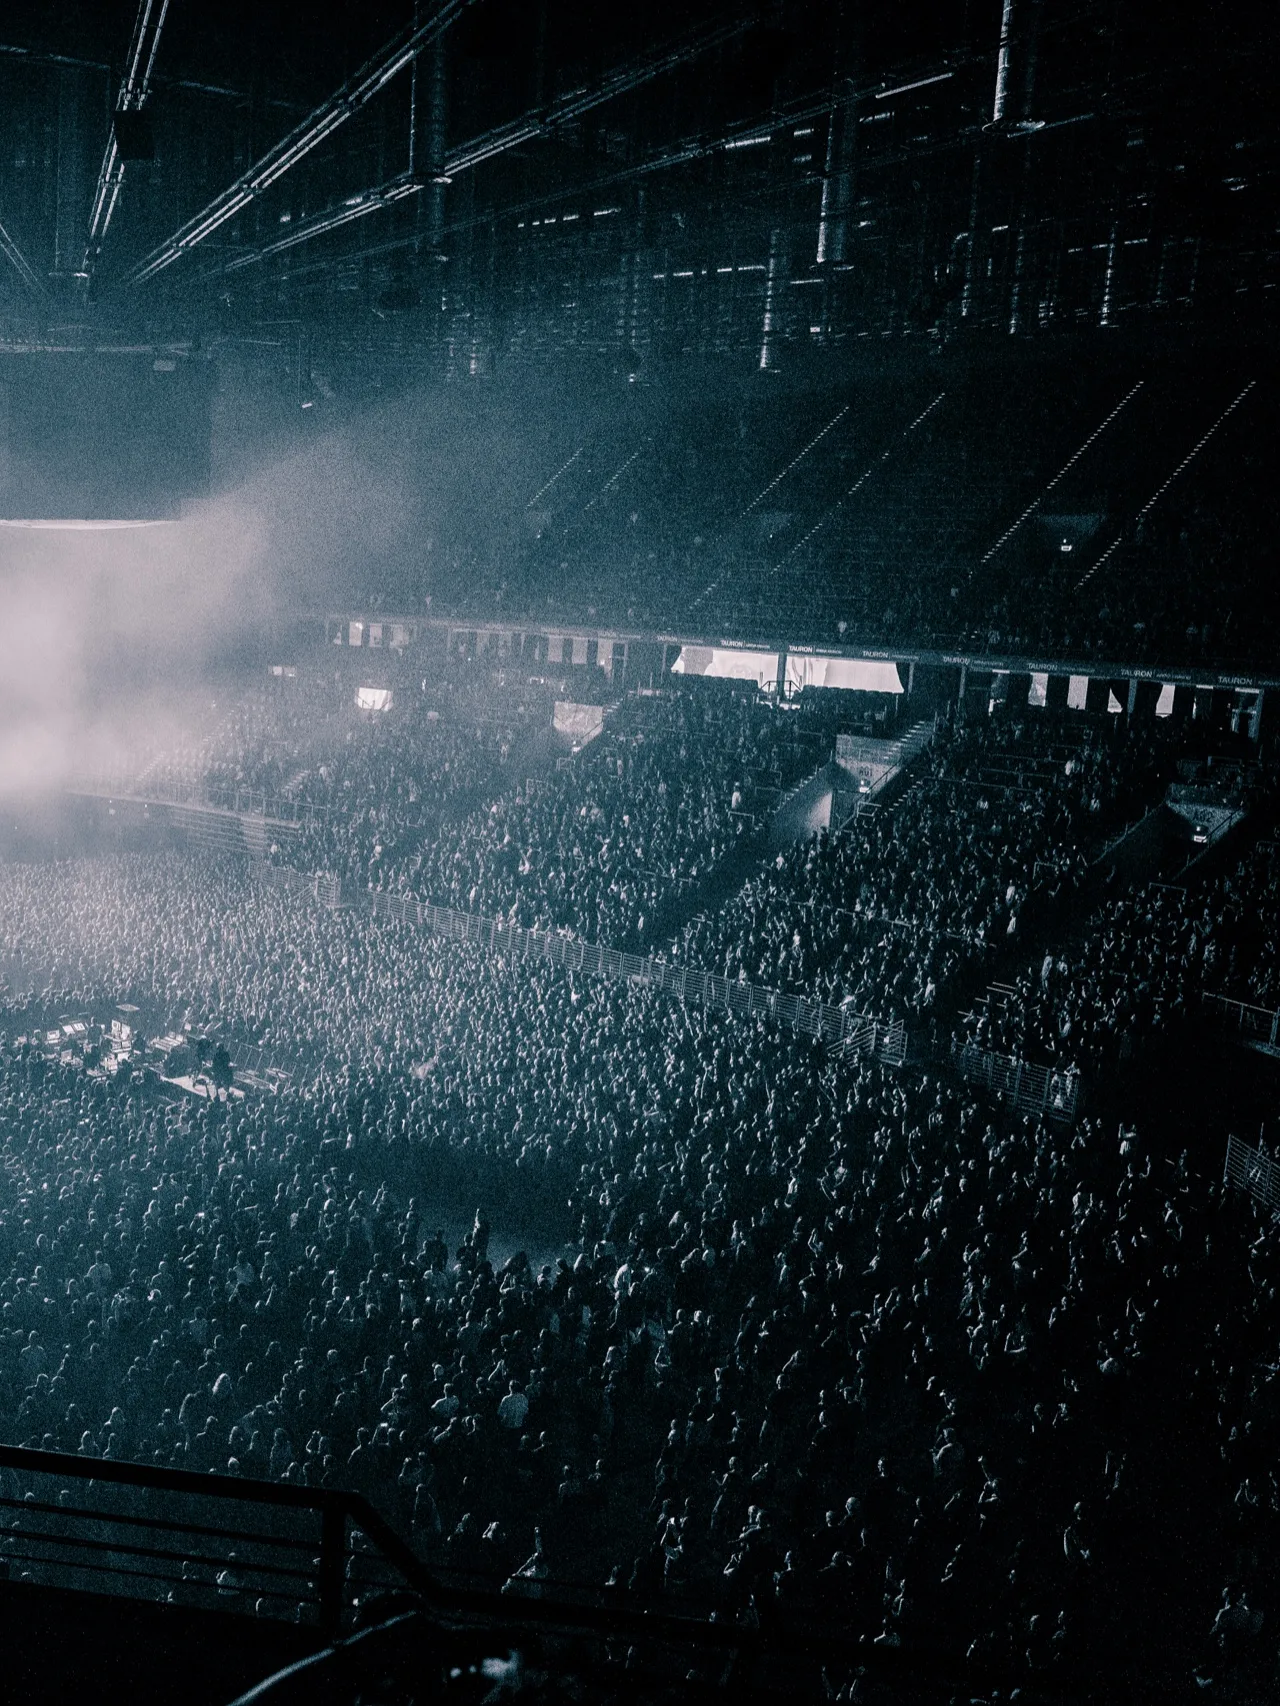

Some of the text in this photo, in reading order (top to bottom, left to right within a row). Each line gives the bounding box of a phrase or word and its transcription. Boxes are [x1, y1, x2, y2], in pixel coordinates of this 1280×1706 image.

[721, 640, 743, 648] TAURON
[789, 645, 813, 653] TAURON
[863, 650, 889, 659] TAURON
[943, 656, 970, 665] TAURON
[1028, 662, 1058, 671] TAURON
[1120, 668, 1153, 678] TAURON
[1218, 676, 1253, 686] TAURON
